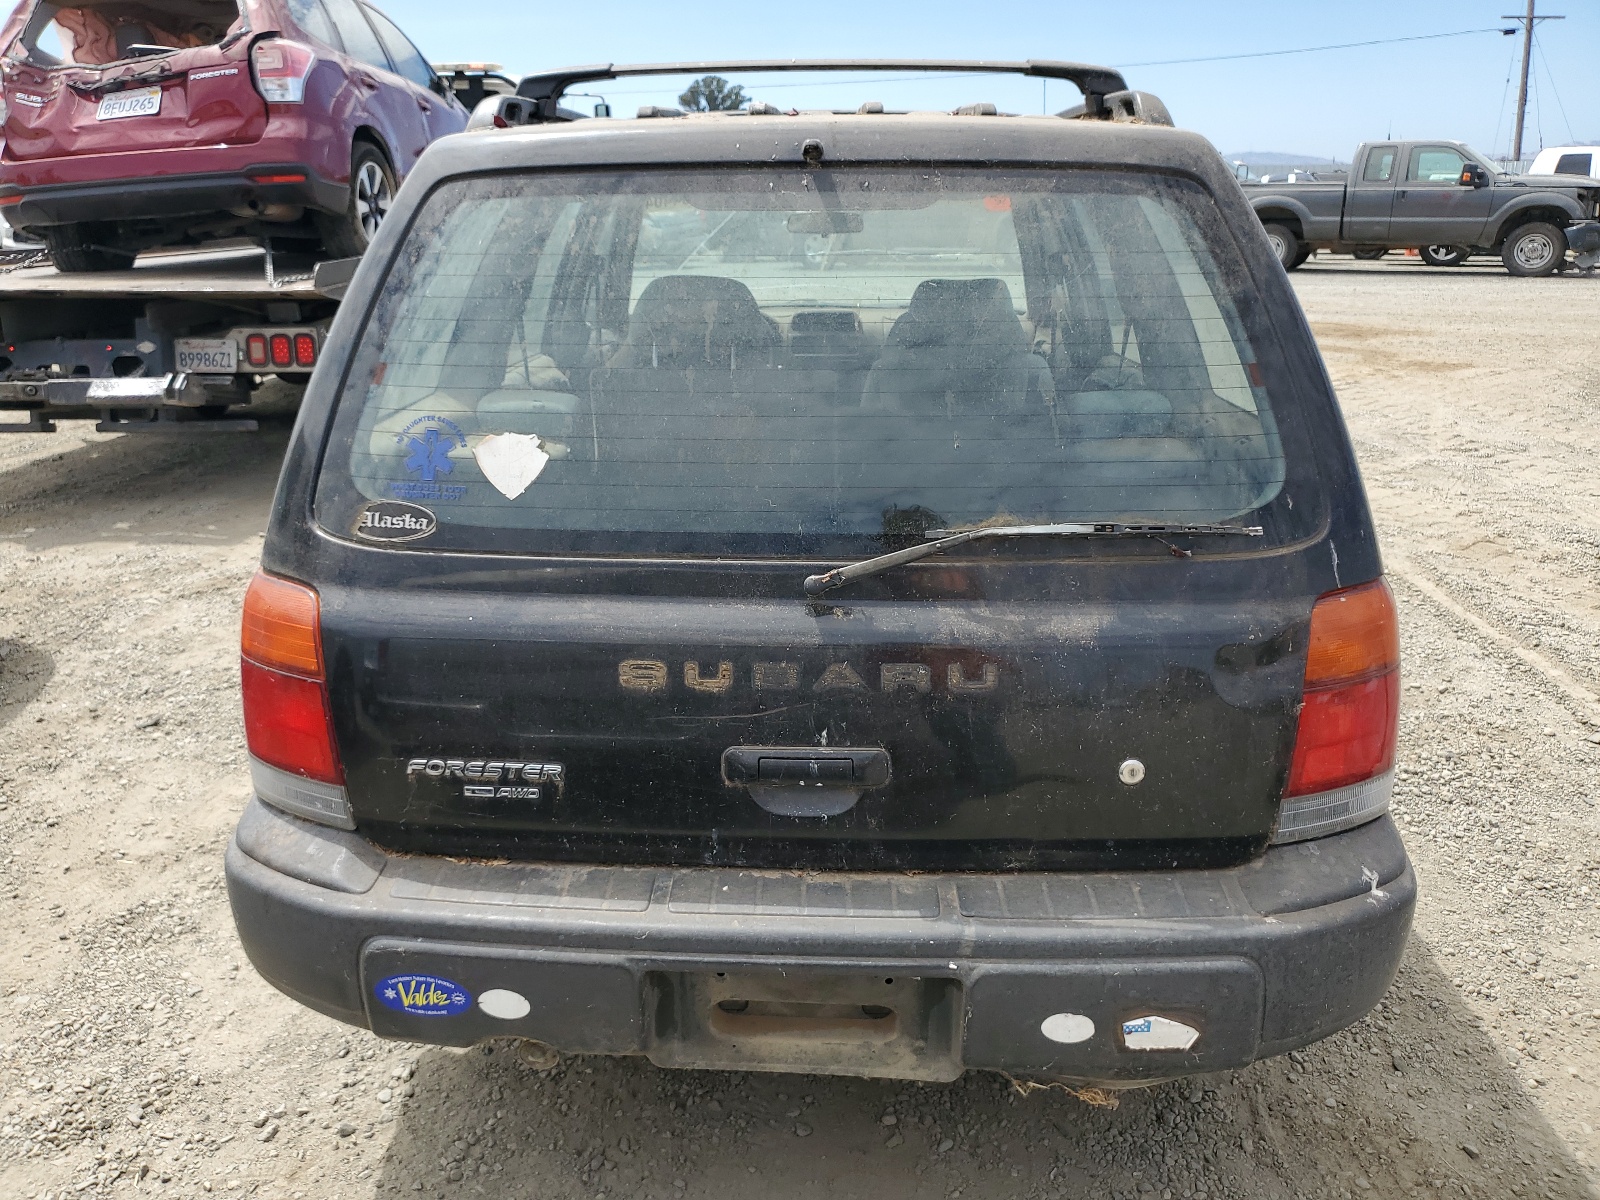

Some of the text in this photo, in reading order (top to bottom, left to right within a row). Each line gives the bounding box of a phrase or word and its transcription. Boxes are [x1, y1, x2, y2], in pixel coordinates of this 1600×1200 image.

[190, 69, 238, 80] FORESTER
[180, 352, 232, 368] 89986Z1
[402, 415, 436, 434] DAUGHTER
[360, 511, 429, 530] Alaska
[618, 659, 1000, 692] SUBARU
[406, 758, 563, 781] FORESTER
[496, 787, 540, 799] AWD
[397, 979, 451, 1007] Valdez
